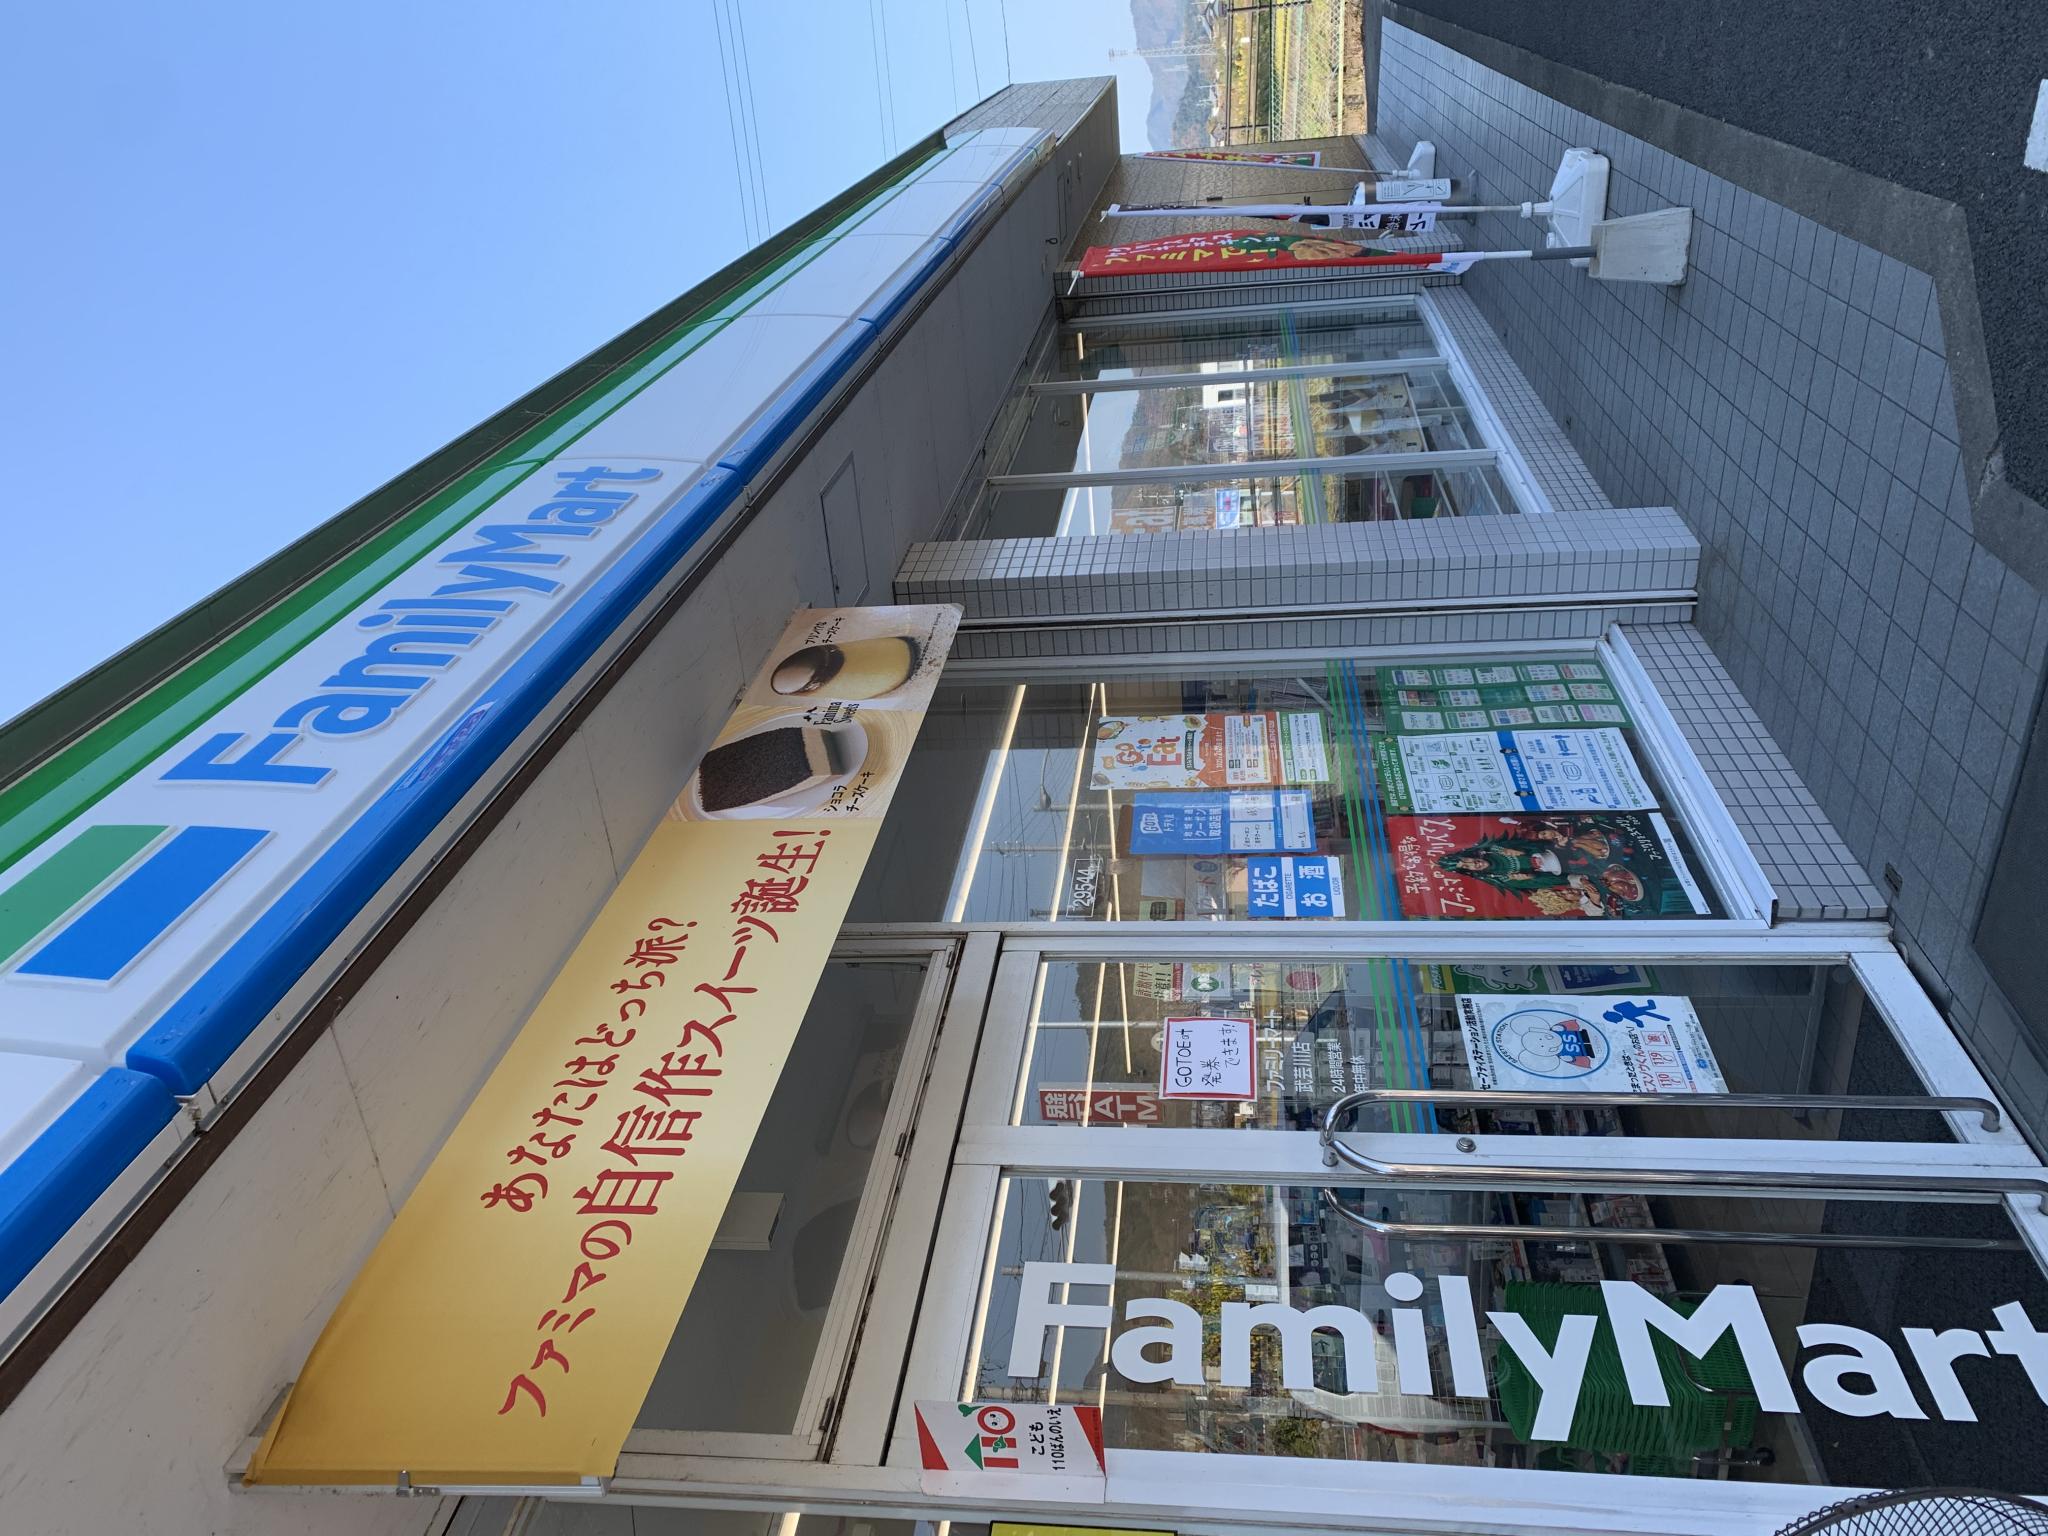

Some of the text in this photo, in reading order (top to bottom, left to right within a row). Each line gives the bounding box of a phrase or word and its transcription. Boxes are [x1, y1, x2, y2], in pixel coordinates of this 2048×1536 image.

[160, 465, 662, 784] FamilyMart
[813, 702, 842, 726] Famima
[833, 703, 860, 724] Sweets
[1115, 742, 1143, 765] Go
[1147, 735, 1182, 766] Eat
[823, 784, 848, 813] ショコラ
[846, 771, 875, 812] チーズケーキ
[1194, 807, 1207, 837] クーポン
[1419, 818, 1456, 857] クリスマス
[1398, 835, 1431, 894] 予約でお得な
[1072, 868, 1095, 907] 29544
[1252, 865, 1279, 907] たばこ
[1284, 872, 1293, 900] CIGARETTE
[1298, 865, 1328, 908] お酒
[1331, 876, 1342, 896] LIQUOR
[1433, 871, 1476, 914] ファミマの
[1218, 1023, 1241, 1068] できます!
[1262, 1008, 1285, 1092] ファミリーマート
[1460, 997, 1491, 1091] セーフティステーション活動実施店
[1495, 1022, 1518, 1063] SAFETY STATION
[1562, 1033, 1580, 1053] SS
[1650, 1051, 1665, 1065] 119
[480, 917, 697, 1213] あなたはどっち派?
[1199, 1056, 1222, 1087] 発券
[1290, 1042, 1314, 1093] 武芸川店
[1327, 1042, 1347, 1093] 24時間営業
[1350, 1054, 1369, 1093] 年中無休
[1658, 1073, 1673, 1087] 110
[497, 829, 831, 1418] ファミマの自信作スイーツ誕生!
[1007, 1261, 2048, 1443] FamilyMart
[1029, 1421, 1045, 1455] こども
[1046, 1407, 1065, 1471] 110ばんのいえ
